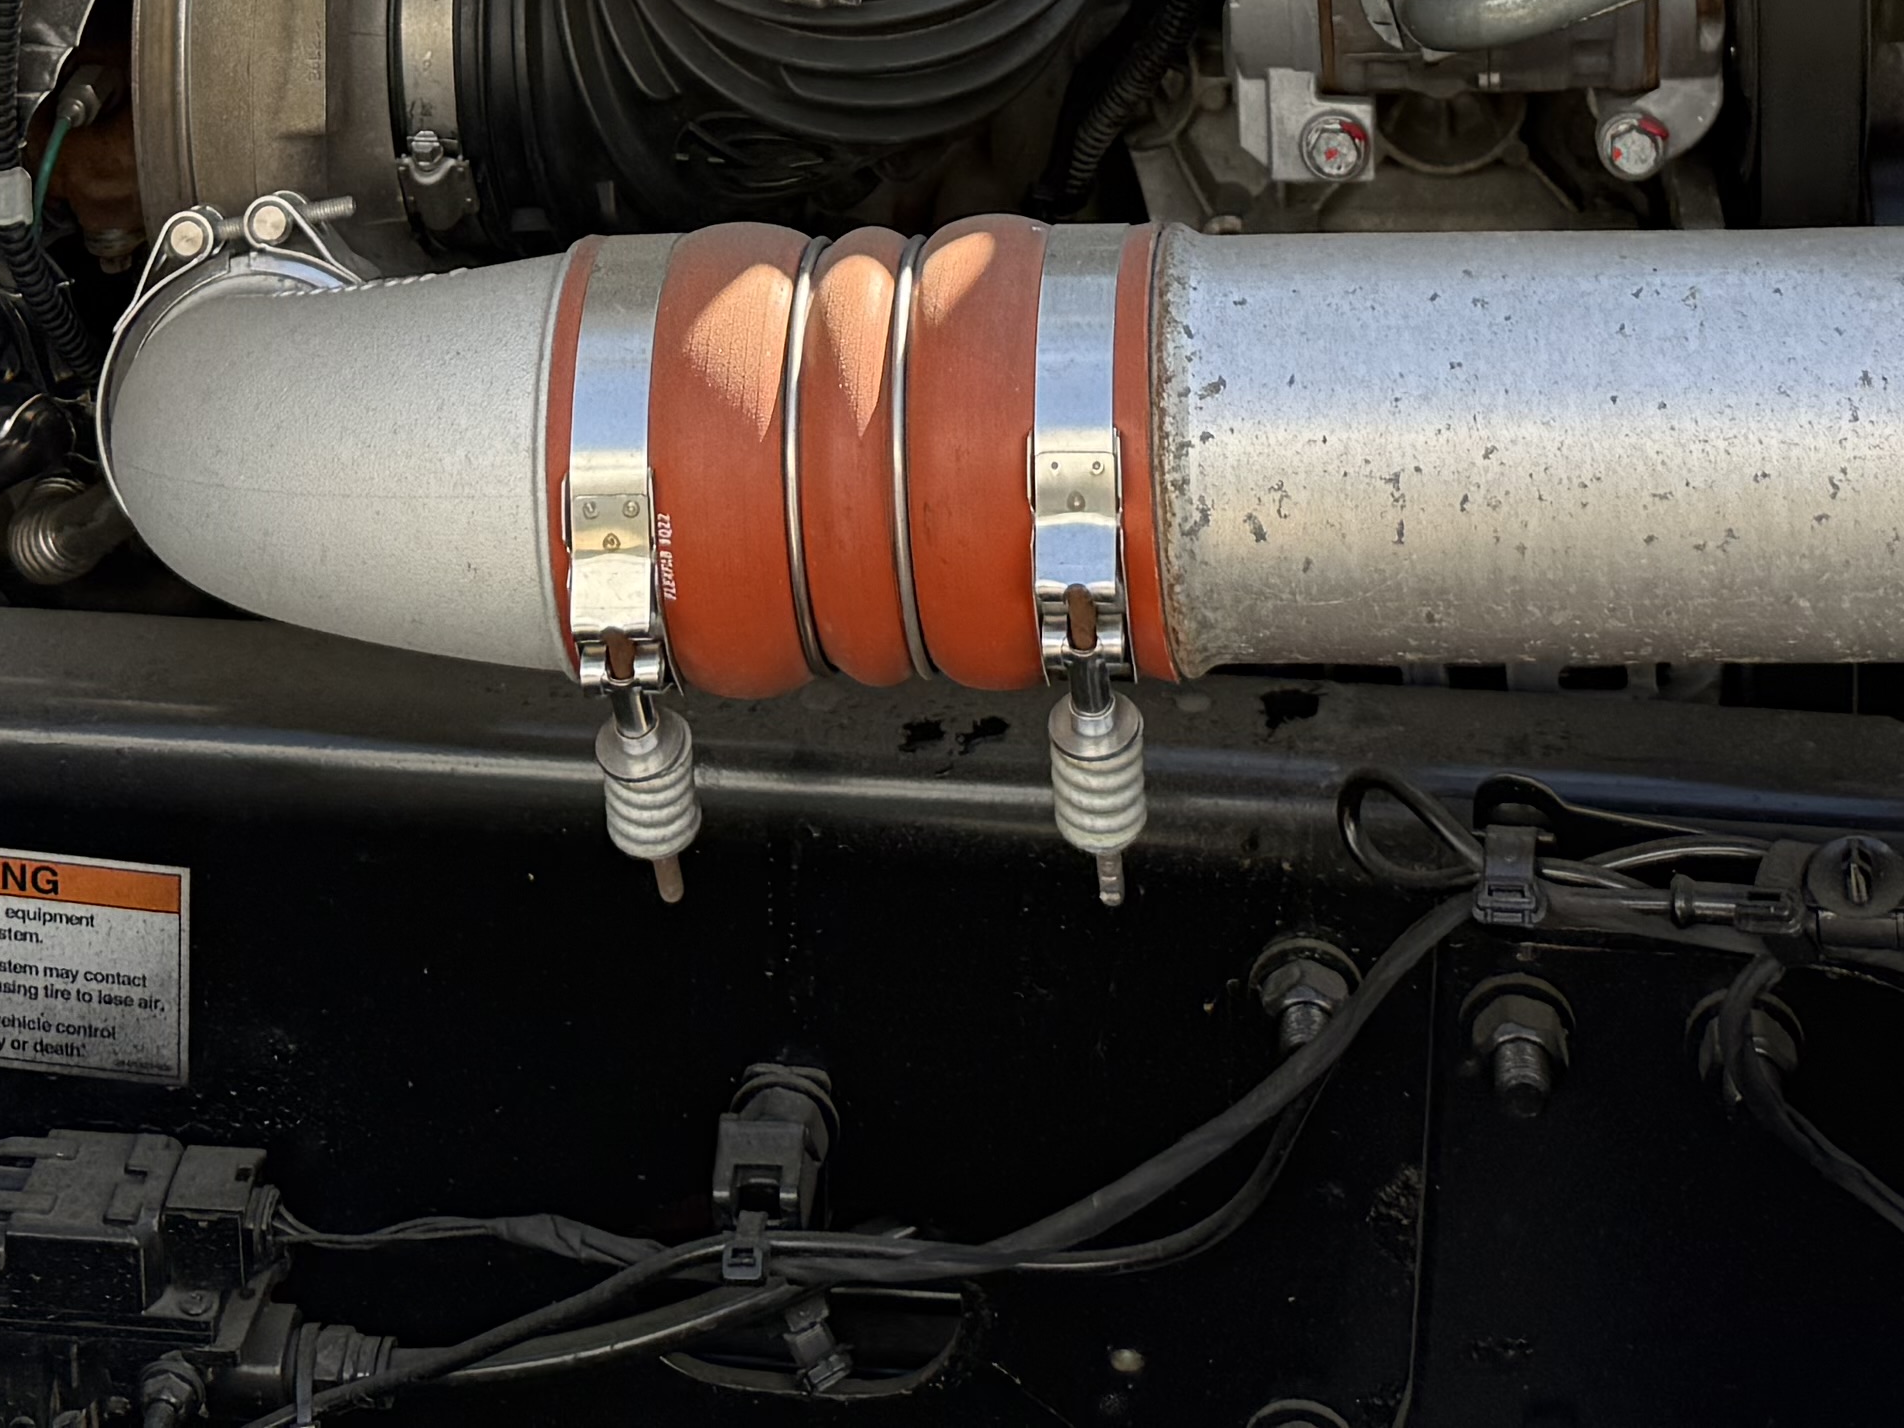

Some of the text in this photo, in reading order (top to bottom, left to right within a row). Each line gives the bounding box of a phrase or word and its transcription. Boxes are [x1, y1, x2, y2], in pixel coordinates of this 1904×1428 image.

[4, 905, 96, 930] equipment
[43, 964, 80, 985] may
[83, 968, 148, 989] contact
[43, 982, 72, 1002] tire
[76, 986, 94, 1004] to
[97, 989, 134, 1008] lose
[55, 1020, 117, 1041] control
[10, 1036, 30, 1052] or
[33, 1035, 87, 1058] death.
